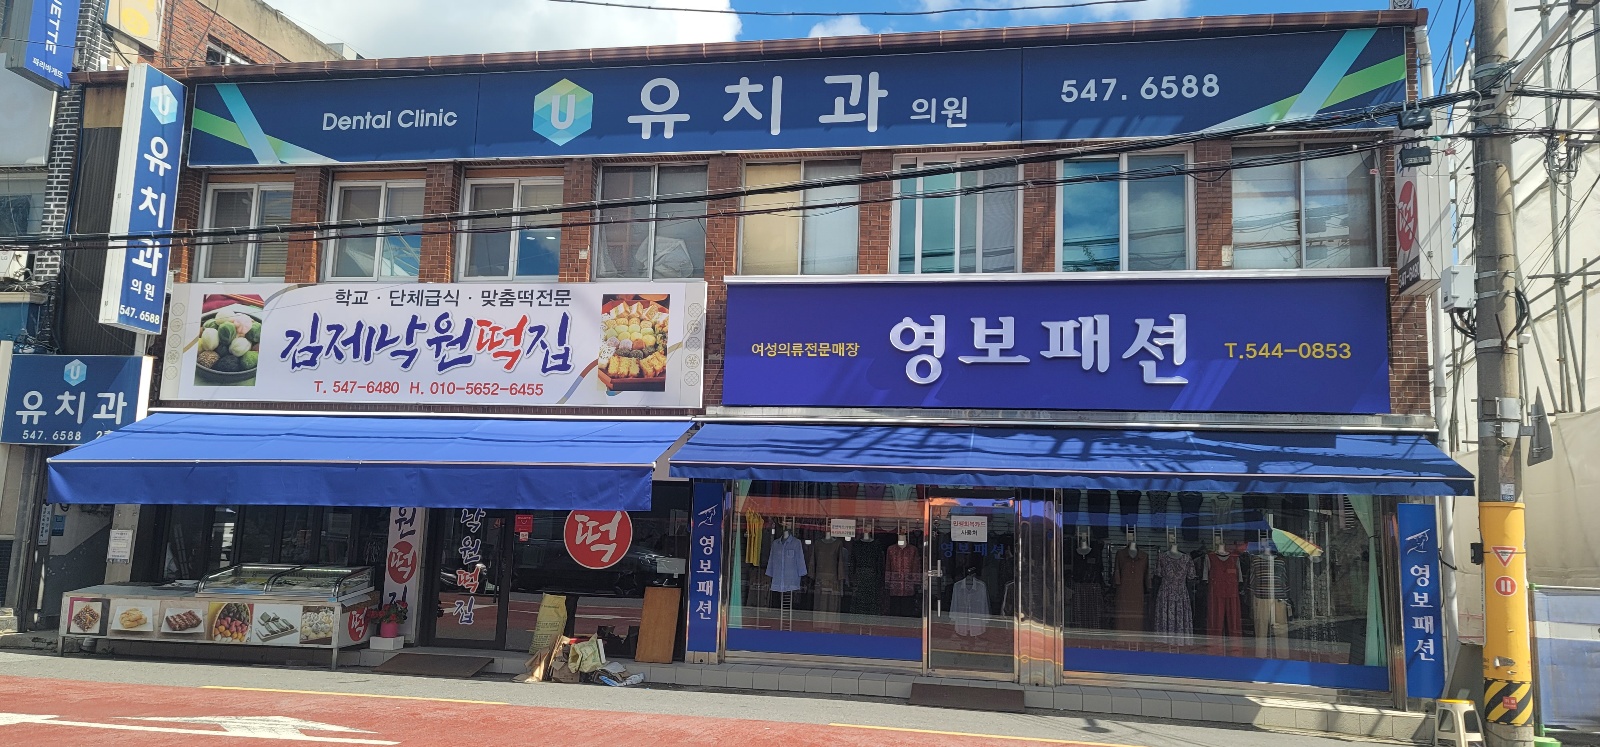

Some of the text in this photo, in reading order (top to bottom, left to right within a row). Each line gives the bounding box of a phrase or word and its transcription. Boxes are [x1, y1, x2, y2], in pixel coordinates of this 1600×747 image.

[45, 0, 62, 55] ETTE
[32, 57, 64, 79] 파리바게뜨
[322, 108, 458, 131] Dental Clinic
[627, 71, 968, 140] 유치과 의원
[130, 136, 172, 302] 유치과 의원
[335, 288, 572, 307] 학교 단체급식 맞춤떡전문
[280, 311, 573, 374] 김제낙원떡집
[751, 342, 860, 358] 여성의류전문매장
[889, 313, 1189, 384] 영보패션
[15, 390, 128, 425] 유치과
[332, 380, 400, 395] 547-6480
[429, 381, 544, 397] 010-5652-6455
[574, 510, 623, 563] 떡
[941, 542, 1005, 560] 영보패션
[453, 508, 486, 625] 낙원떡집
[695, 535, 715, 620] 영보패션
[1410, 564, 1435, 662] 영보패션
